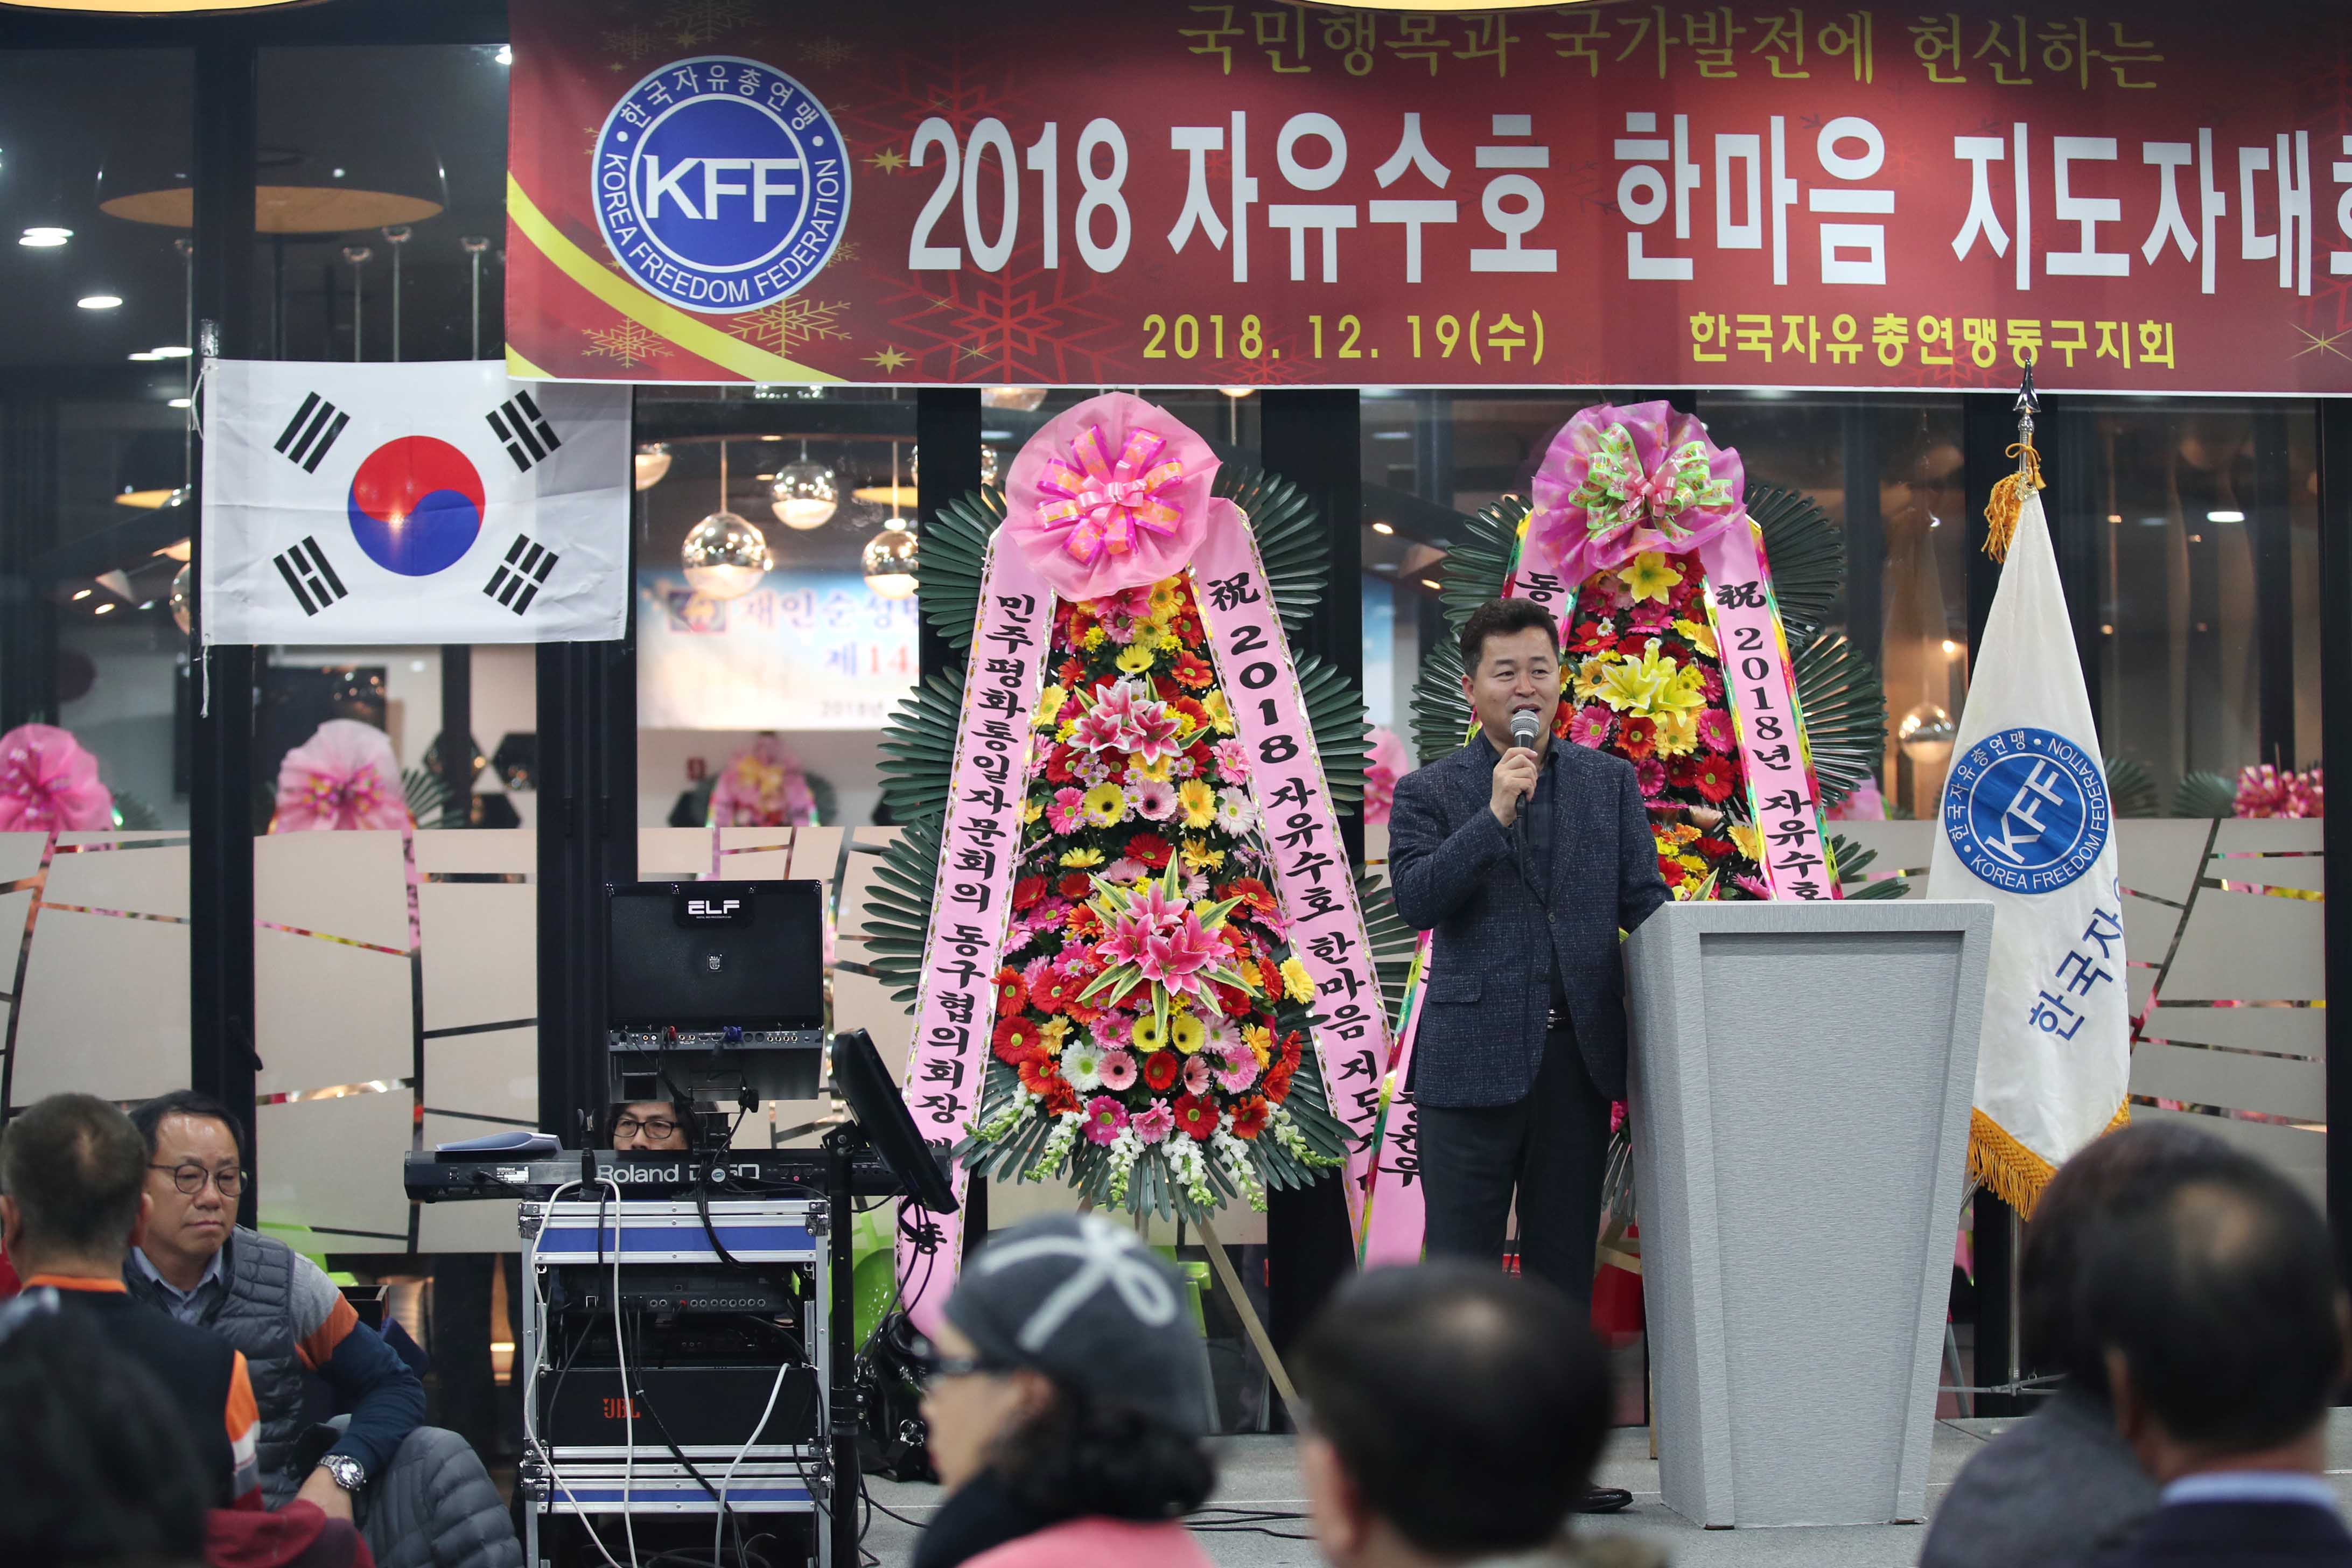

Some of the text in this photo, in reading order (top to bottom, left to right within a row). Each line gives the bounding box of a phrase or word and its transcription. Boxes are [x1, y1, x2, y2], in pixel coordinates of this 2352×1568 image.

[1546, 5, 1873, 85] 국가발전에
[1907, 13, 2165, 89] 헌신하는
[621, 65, 820, 131] 한국자유총연맹
[603, 152, 839, 303] KOREA FREEDOM FEDERATION
[642, 154, 800, 222] KFF
[908, 117, 1131, 274] 2018
[1166, 110, 1558, 283] 자유수호
[1614, 112, 1895, 286] 한마음
[1143, 310, 1544, 366] 2018. 12. 19(수)
[1689, 311, 2175, 370] 한국자유총연맹동구지회
[1207, 572, 1261, 612] 祝
[1716, 580, 1767, 610] 祝
[1230, 625, 1299, 764] 2018
[1734, 627, 1791, 771] 2018년
[1947, 730, 2025, 843] 한국자유총연맹
[1970, 738, 2106, 890] KOREA FREEDOM FEDERATION
[1984, 759, 2064, 865] KFF
[915, 593, 1036, 1124] 민주평화통일자문회의 동구협의회장
[1267, 777, 1345, 922] 자유수호
[688, 900, 740, 914] ELF
[1306, 932, 1371, 1041] 한마음
[597, 1164, 679, 1184] Roland
[603, 1398, 641, 1418] JBL
